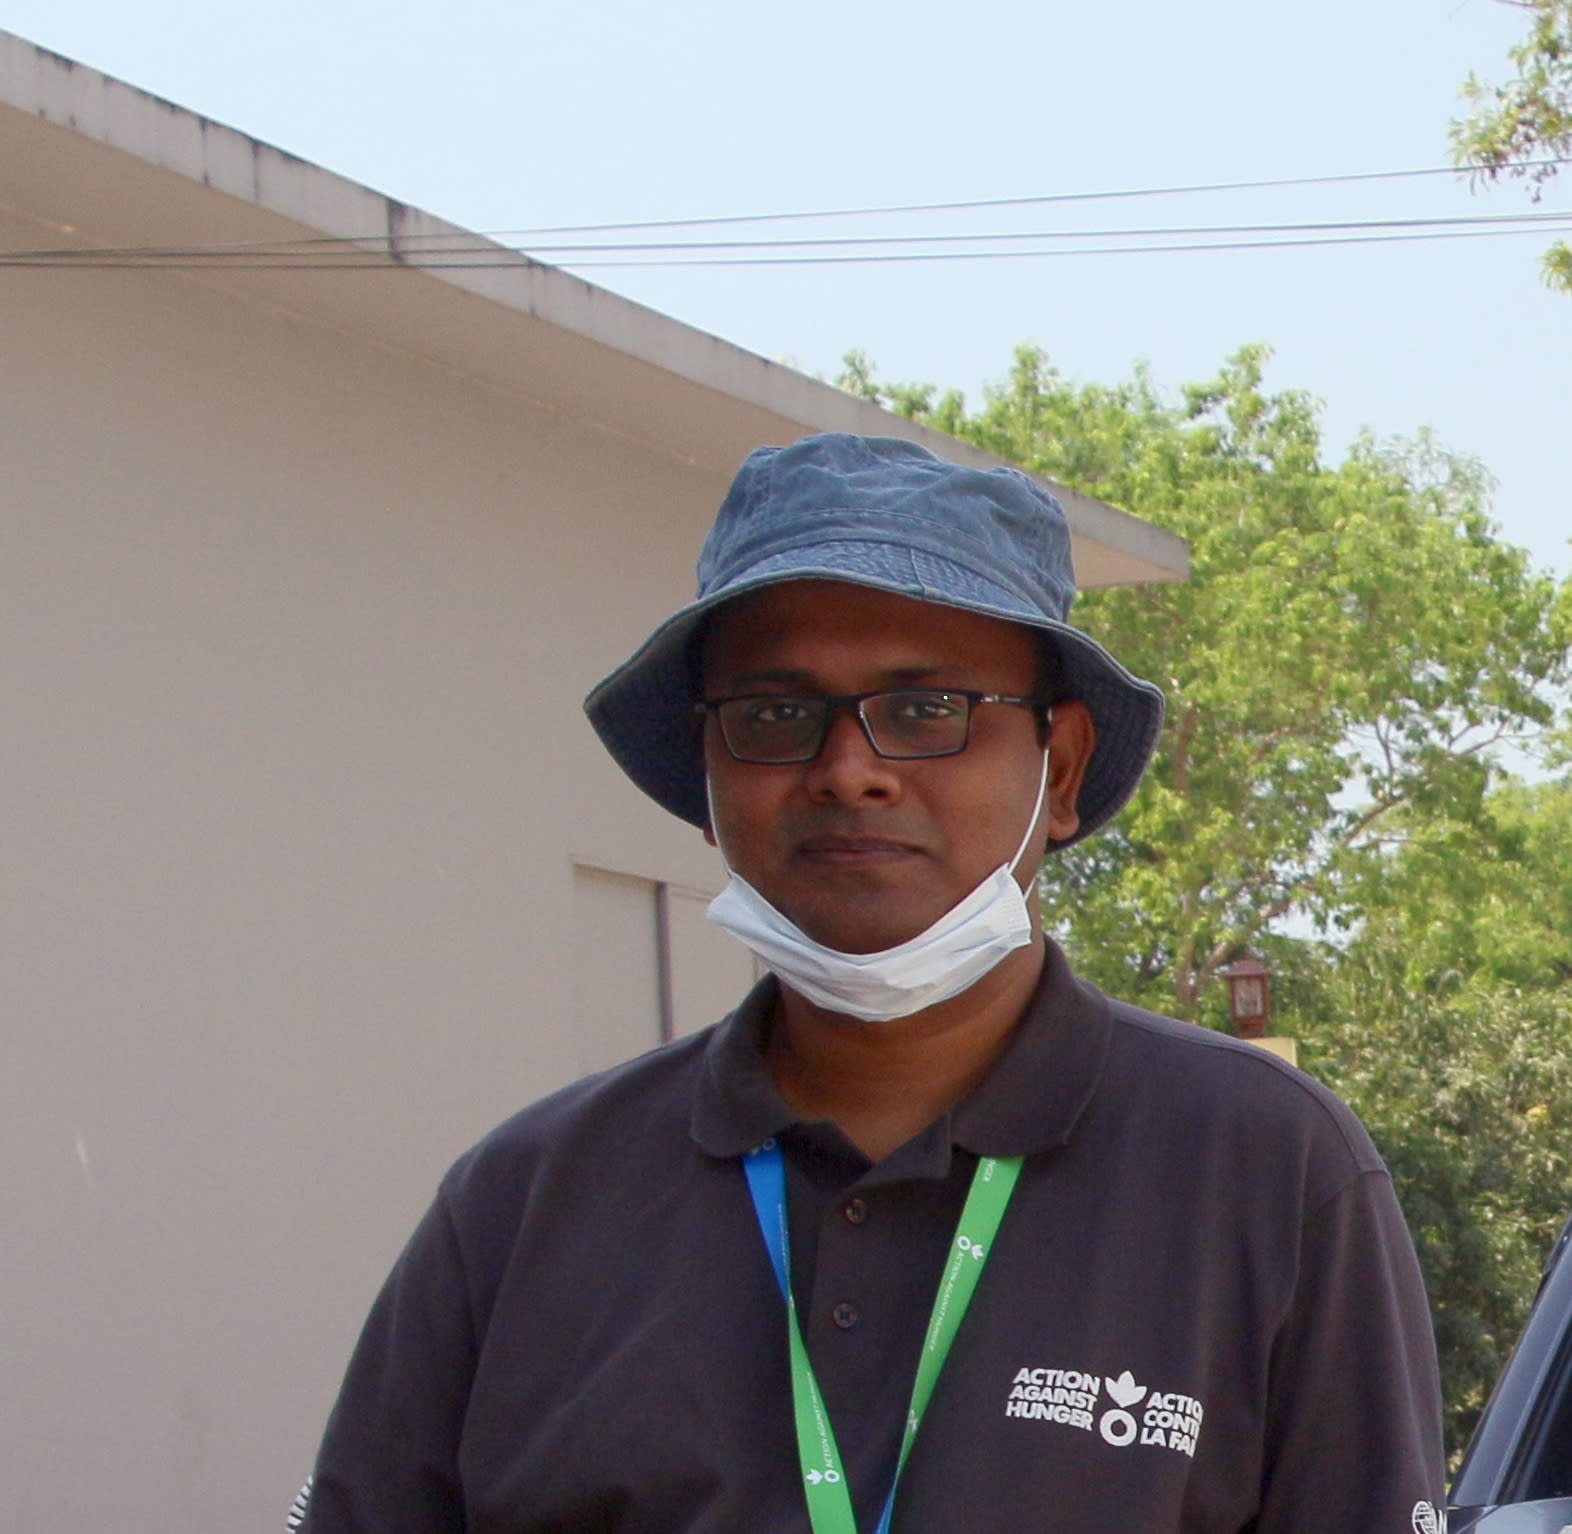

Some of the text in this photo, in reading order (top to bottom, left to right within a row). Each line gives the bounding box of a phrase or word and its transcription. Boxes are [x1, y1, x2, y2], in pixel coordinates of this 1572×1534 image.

[1013, 1367, 1101, 1395] ACTION
[1009, 1385, 1098, 1411] AGAINST
[1146, 1391, 1204, 1424] ACTIO
[1005, 1401, 1094, 1431] HUNGER
[1143, 1409, 1201, 1440] CONT
[1139, 1427, 1197, 1458] LA FAI
